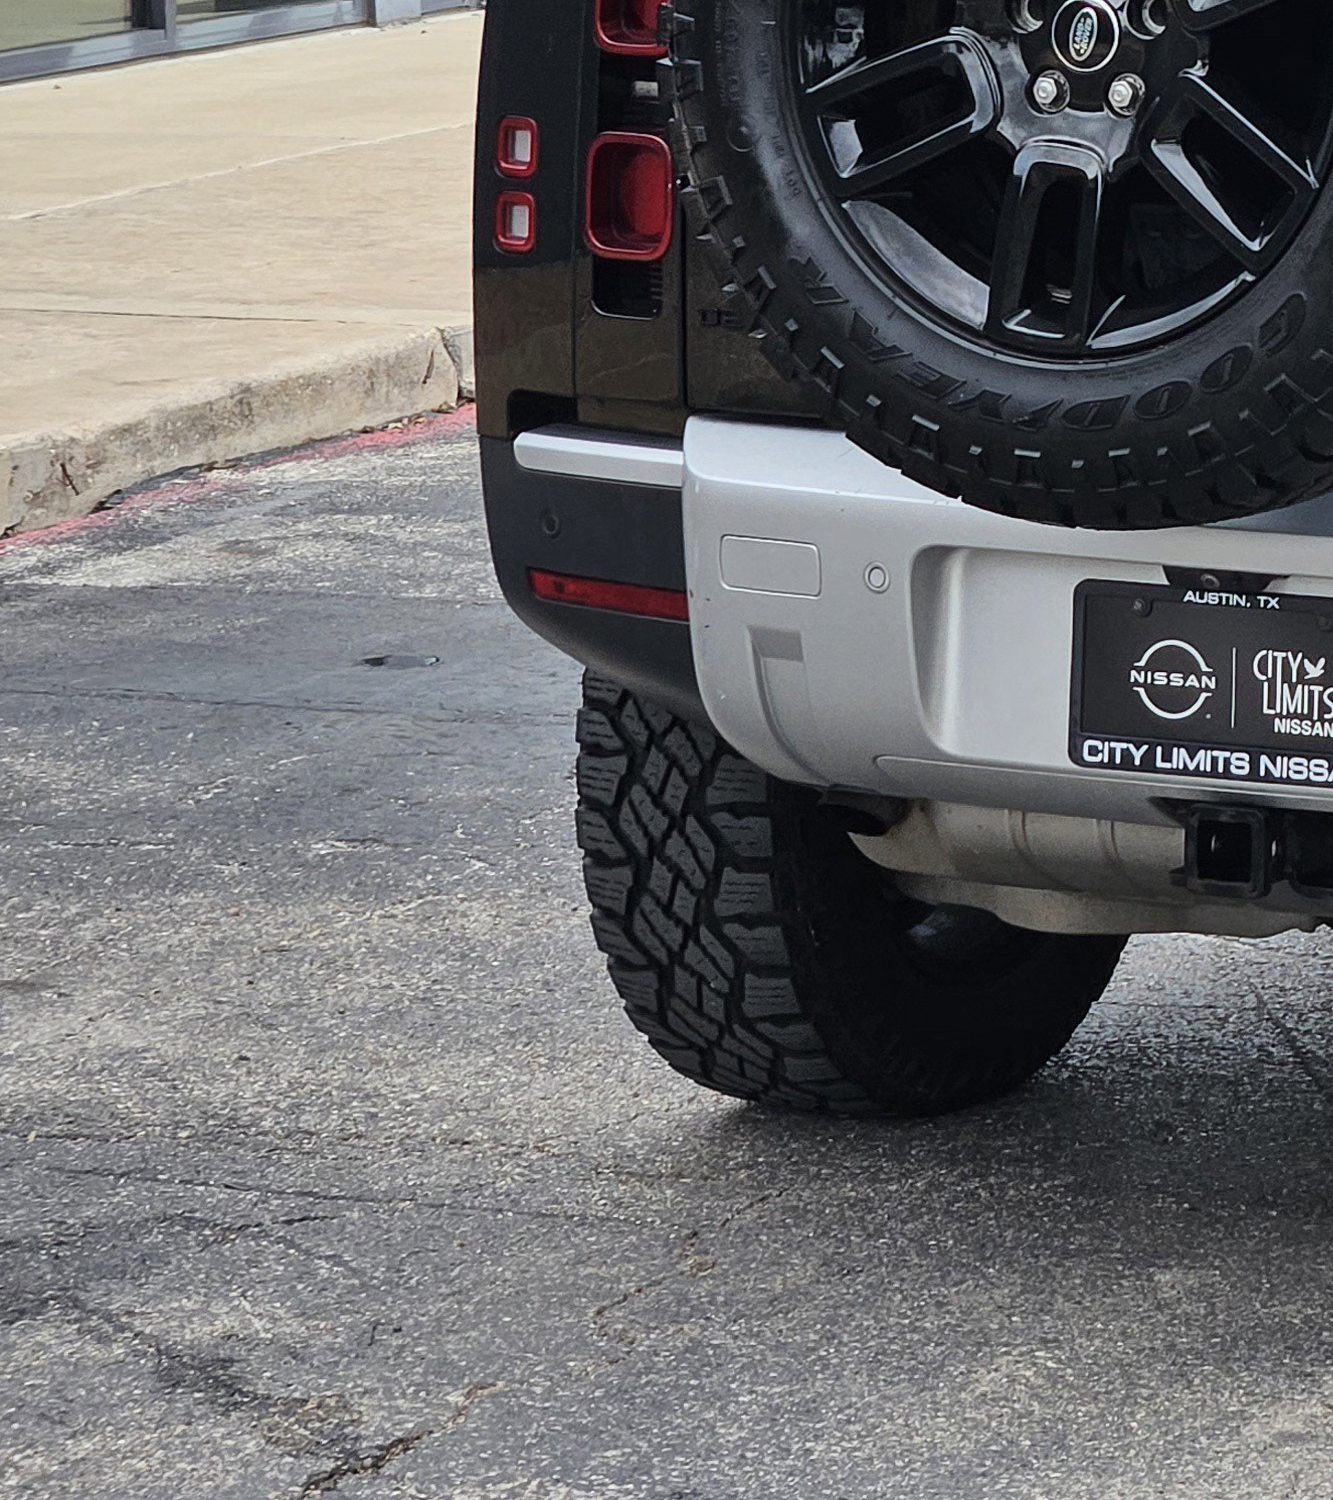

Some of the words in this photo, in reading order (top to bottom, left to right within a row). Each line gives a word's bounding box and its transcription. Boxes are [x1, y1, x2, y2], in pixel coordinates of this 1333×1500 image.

[788, 257, 1306, 431] GOODYEAR
[1183, 590, 1250, 609] AUSTIN,
[1257, 596, 1280, 610] TX
[1130, 669, 1216, 690] NISSAN
[1253, 649, 1302, 683] CITY
[1082, 739, 1149, 767] CITY
[1155, 747, 1250, 776] LIMITS
